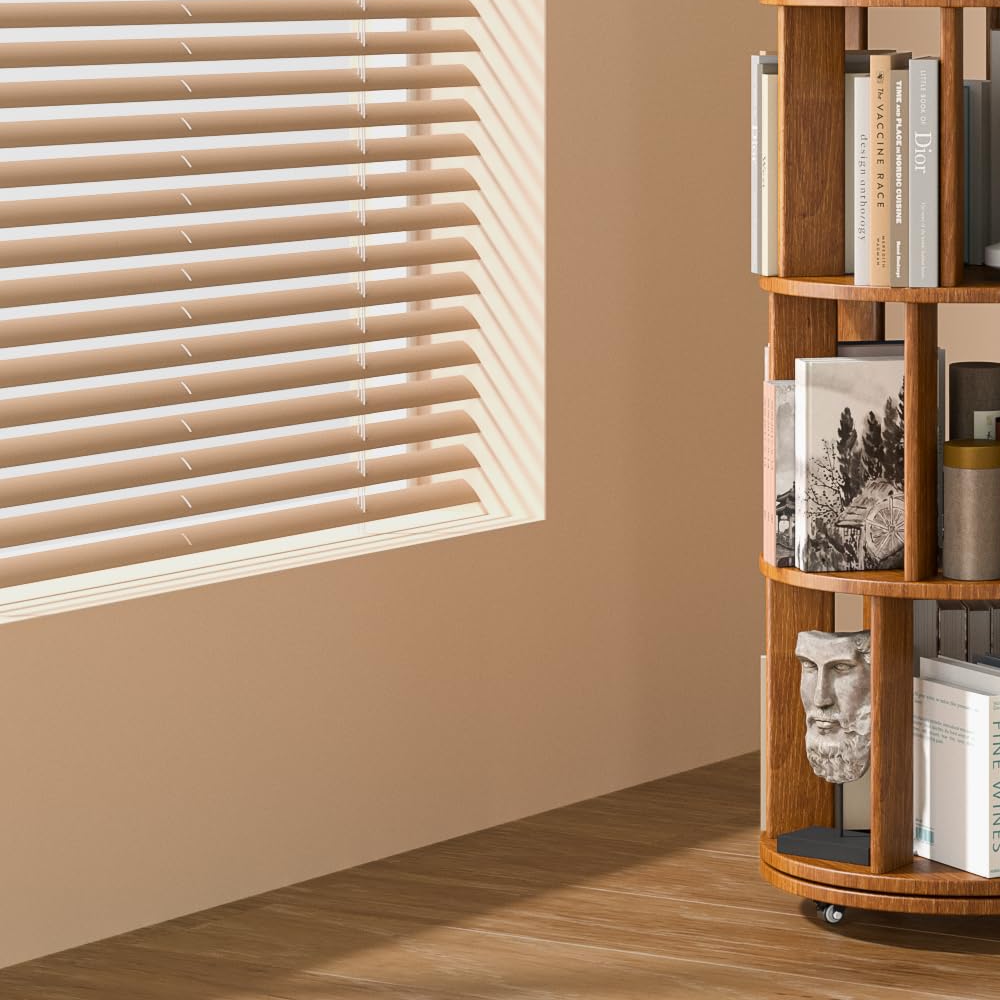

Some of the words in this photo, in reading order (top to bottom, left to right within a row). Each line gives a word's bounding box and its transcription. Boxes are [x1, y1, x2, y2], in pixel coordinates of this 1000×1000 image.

[858, 134, 868, 175] design
[876, 104, 884, 166] VACCINE
[914, 131, 932, 175] Dior
[876, 173, 884, 208] RACE
